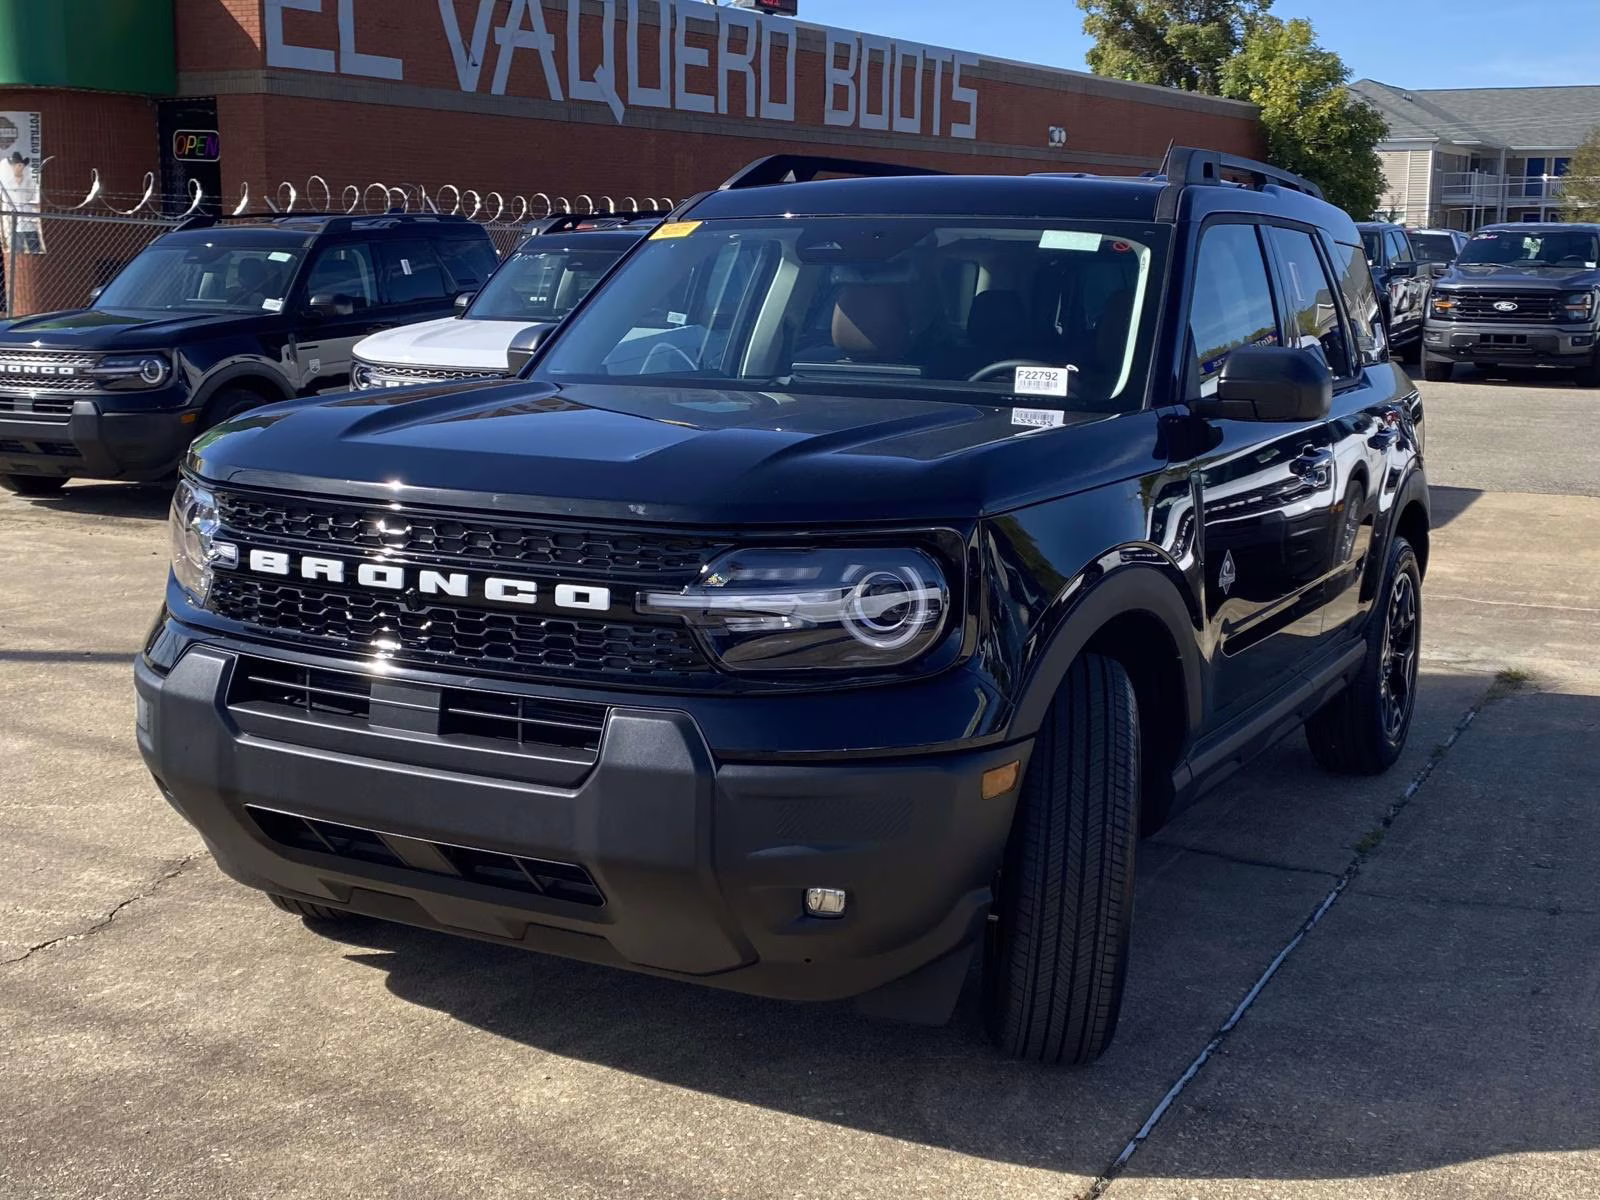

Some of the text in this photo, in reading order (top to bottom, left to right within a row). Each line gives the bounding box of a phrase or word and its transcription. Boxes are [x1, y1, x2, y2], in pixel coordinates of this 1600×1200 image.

[264, 0, 979, 139] EL VAQUERO BOOTS
[176, 135, 218, 156] OPEN
[1017, 370, 1058, 380] F22792
[250, 549, 611, 611] BRONCO
